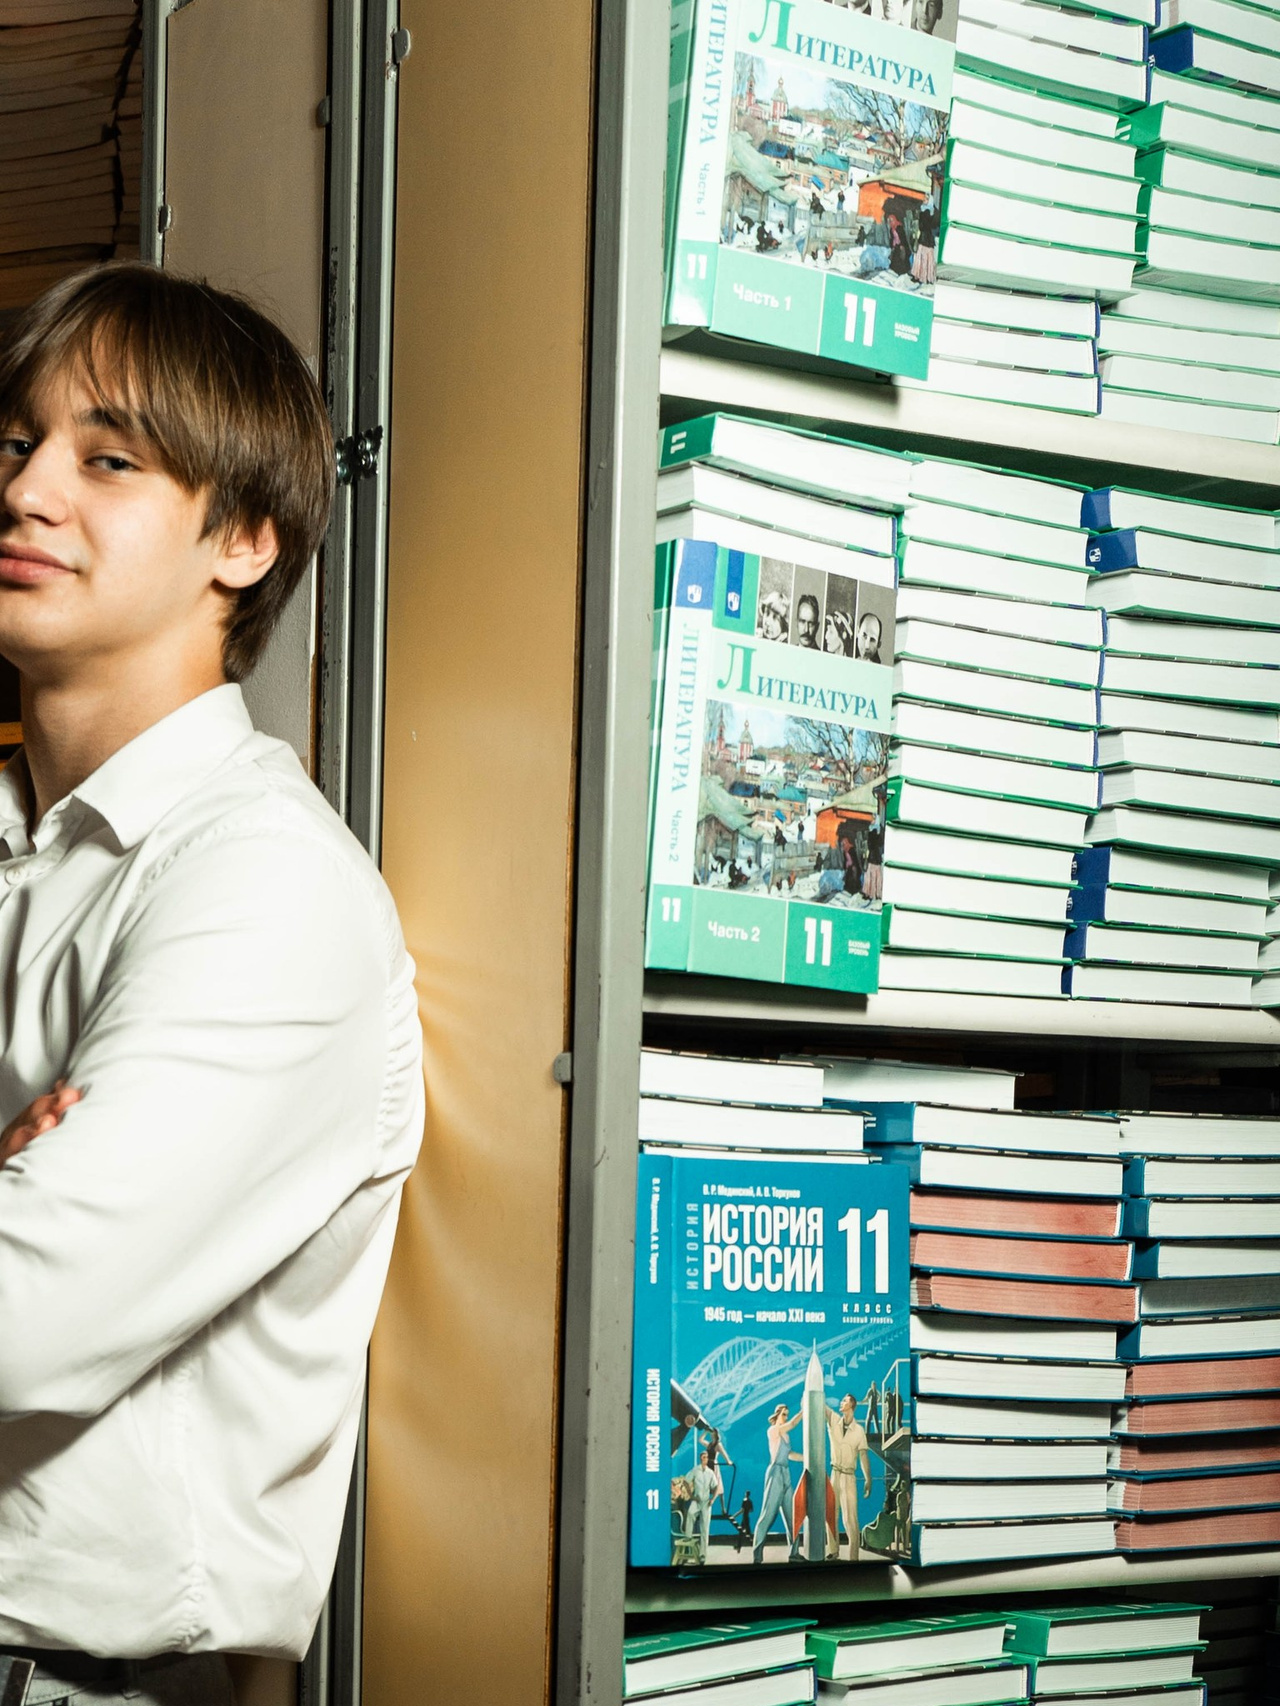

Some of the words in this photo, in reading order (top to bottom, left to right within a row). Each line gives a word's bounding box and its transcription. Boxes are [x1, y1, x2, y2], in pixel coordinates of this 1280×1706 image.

[686, 253, 708, 280] 11
[733, 282, 780, 308] Часть
[784, 295, 792, 312] 1
[844, 292, 877, 347] 11
[716, 642, 879, 720] ЛИТЕРАТУРА
[671, 624, 699, 793] ЛИТЕРАТУРА
[661, 897, 681, 923] 11
[708, 920, 748, 941] Часть
[751, 926, 760, 942] 2
[804, 917, 832, 967] 11
[686, 1202, 699, 1290] ИСТОРИЯ
[703, 1203, 823, 1246] ИСТОРИЯ
[703, 1244, 823, 1293] РОССИИ
[837, 1207, 889, 1294] 11
[704, 1307, 725, 1322] 1945
[727, 1309, 743, 1324] год
[756, 1310, 787, 1323] начало
[788, 1308, 804, 1323] XXI
[805, 1310, 826, 1323] века
[646, 1368, 660, 1422] ИСТОРИЯ
[646, 1425, 660, 1473] РОССИИ
[646, 1489, 659, 1510] 11
